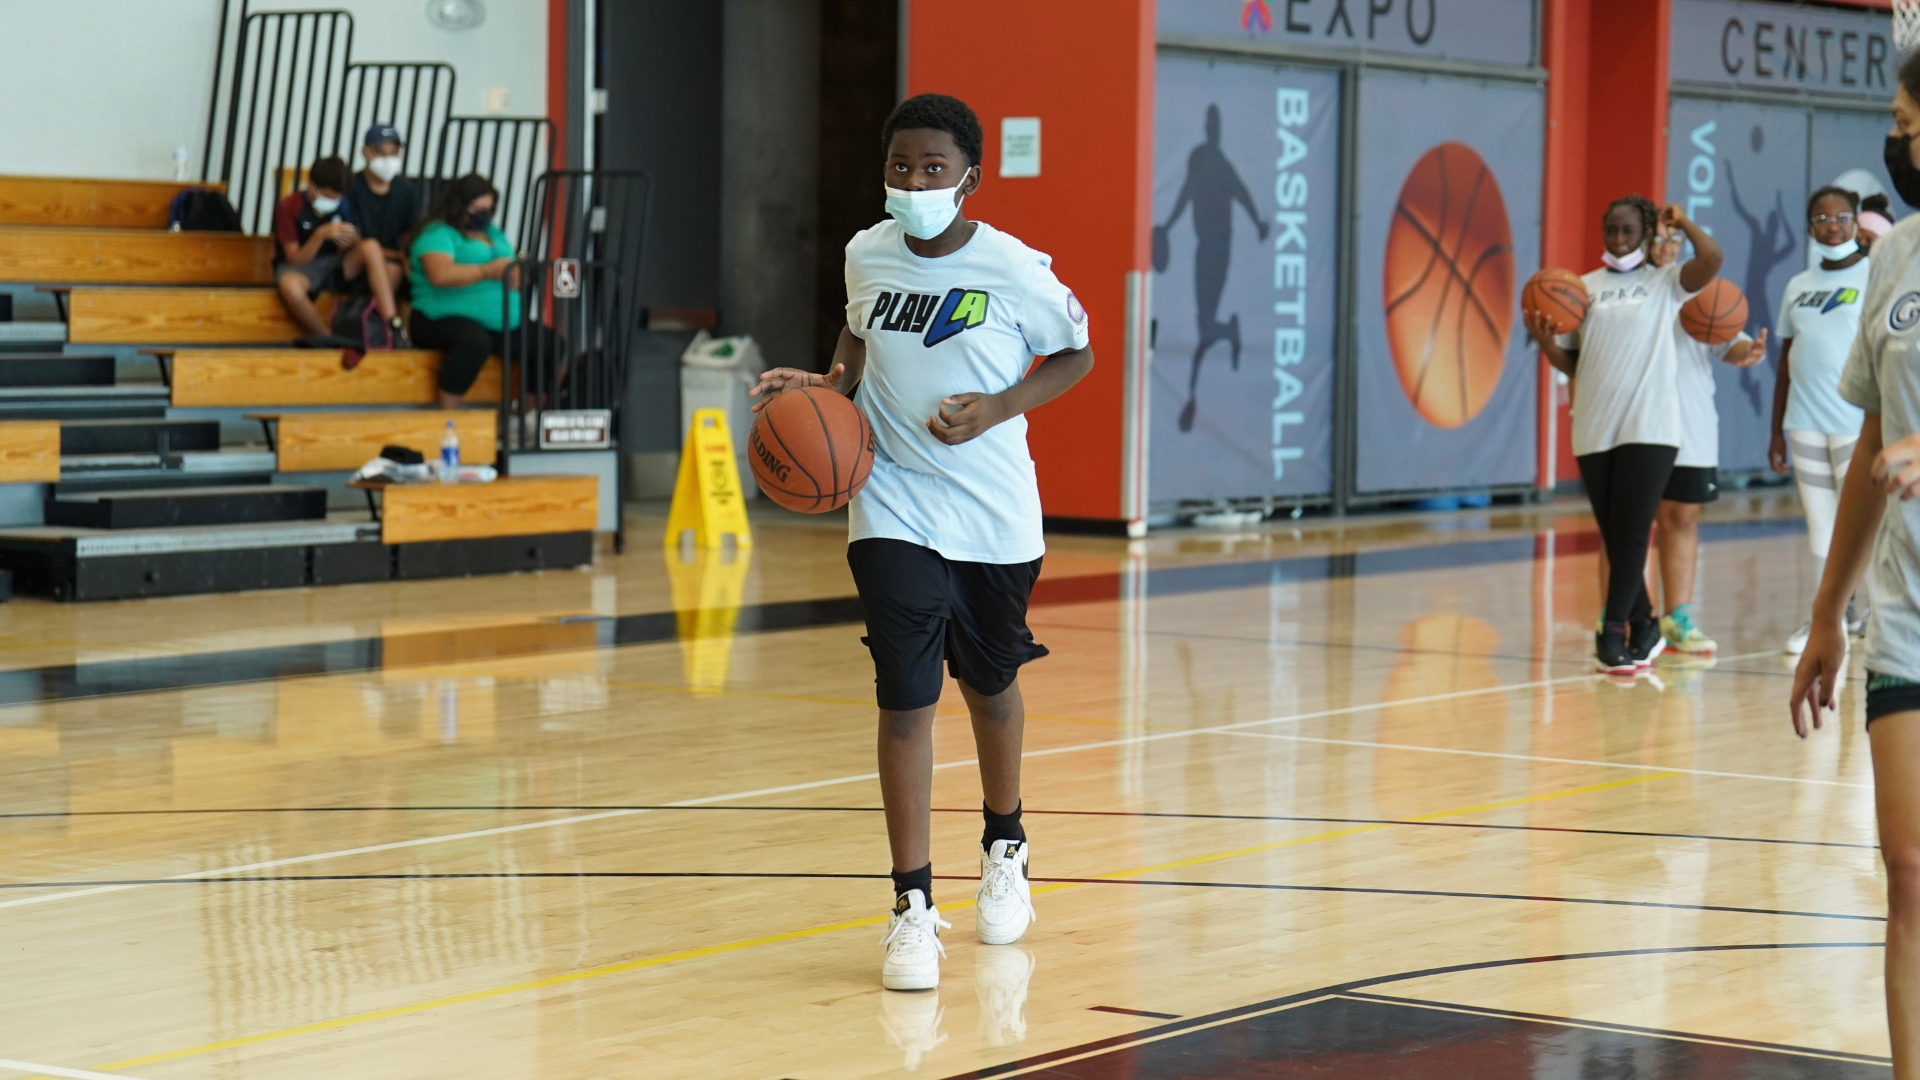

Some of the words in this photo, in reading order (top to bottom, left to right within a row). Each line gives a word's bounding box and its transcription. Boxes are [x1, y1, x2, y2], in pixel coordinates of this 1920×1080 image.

[1286, 0, 1436, 45] EXPO
[1721, 16, 1887, 88] CENTER
[1271, 87, 1309, 481] BASKETBALL
